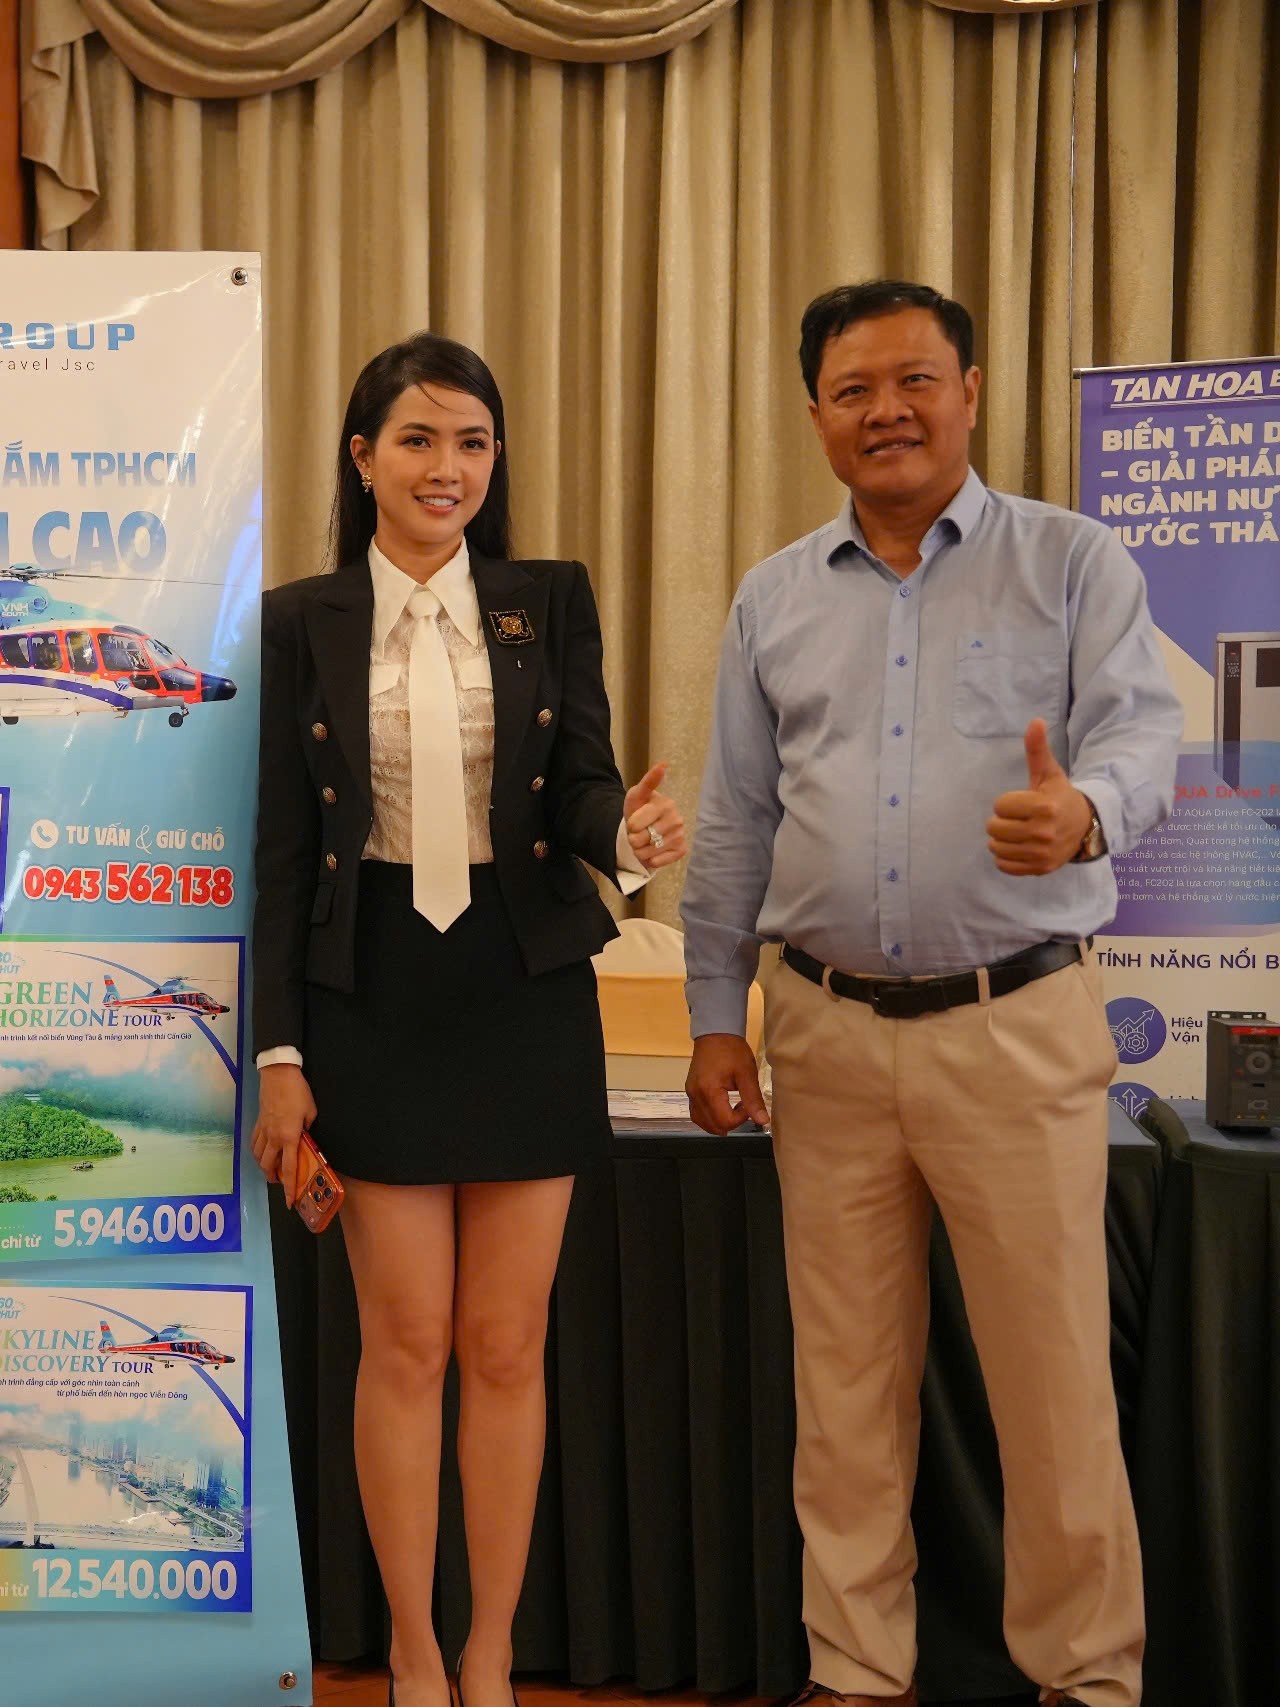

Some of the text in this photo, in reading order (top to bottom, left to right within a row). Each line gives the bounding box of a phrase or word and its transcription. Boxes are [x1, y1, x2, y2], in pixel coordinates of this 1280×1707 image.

[61, 357, 96, 371] Jsc
[1110, 370, 1264, 402] TAN HOA
[1101, 416, 1175, 451] BIẾN
[1184, 413, 1254, 447] TẦN
[70, 451, 197, 487] TPHCM
[1128, 447, 1280, 483] GIẢI PHÁ
[1100, 485, 1217, 516] NGÀNH
[1209, 512, 1280, 544] THẢ
[31, 510, 167, 574] CAO
[1, 603, 29, 611] VNH
[1215, 785, 1262, 799] Drive
[1184, 808, 1273, 817] AQUA Drive FC-202
[66, 822, 225, 854] TƯ VẤN & GIỮ CHỖ
[23, 861, 234, 908] 0943 562 138
[1145, 878, 1174, 887] FC202
[1096, 946, 1280, 969] TÍNH NĂNG NỔI B
[122, 1014, 163, 1027] TOUR
[1171, 1016, 1203, 1030] Hiệu
[1171, 1031, 1200, 1044] Vận
[1, 1233, 23, 1249] chỉ
[24, 1234, 42, 1248] từ
[53, 1202, 225, 1248] 5.946.000
[112, 1360, 154, 1374] TOUR
[167, 1391, 188, 1400] Đông
[11, 1582, 30, 1597] từ
[32, 1558, 237, 1600] 12.540.000
